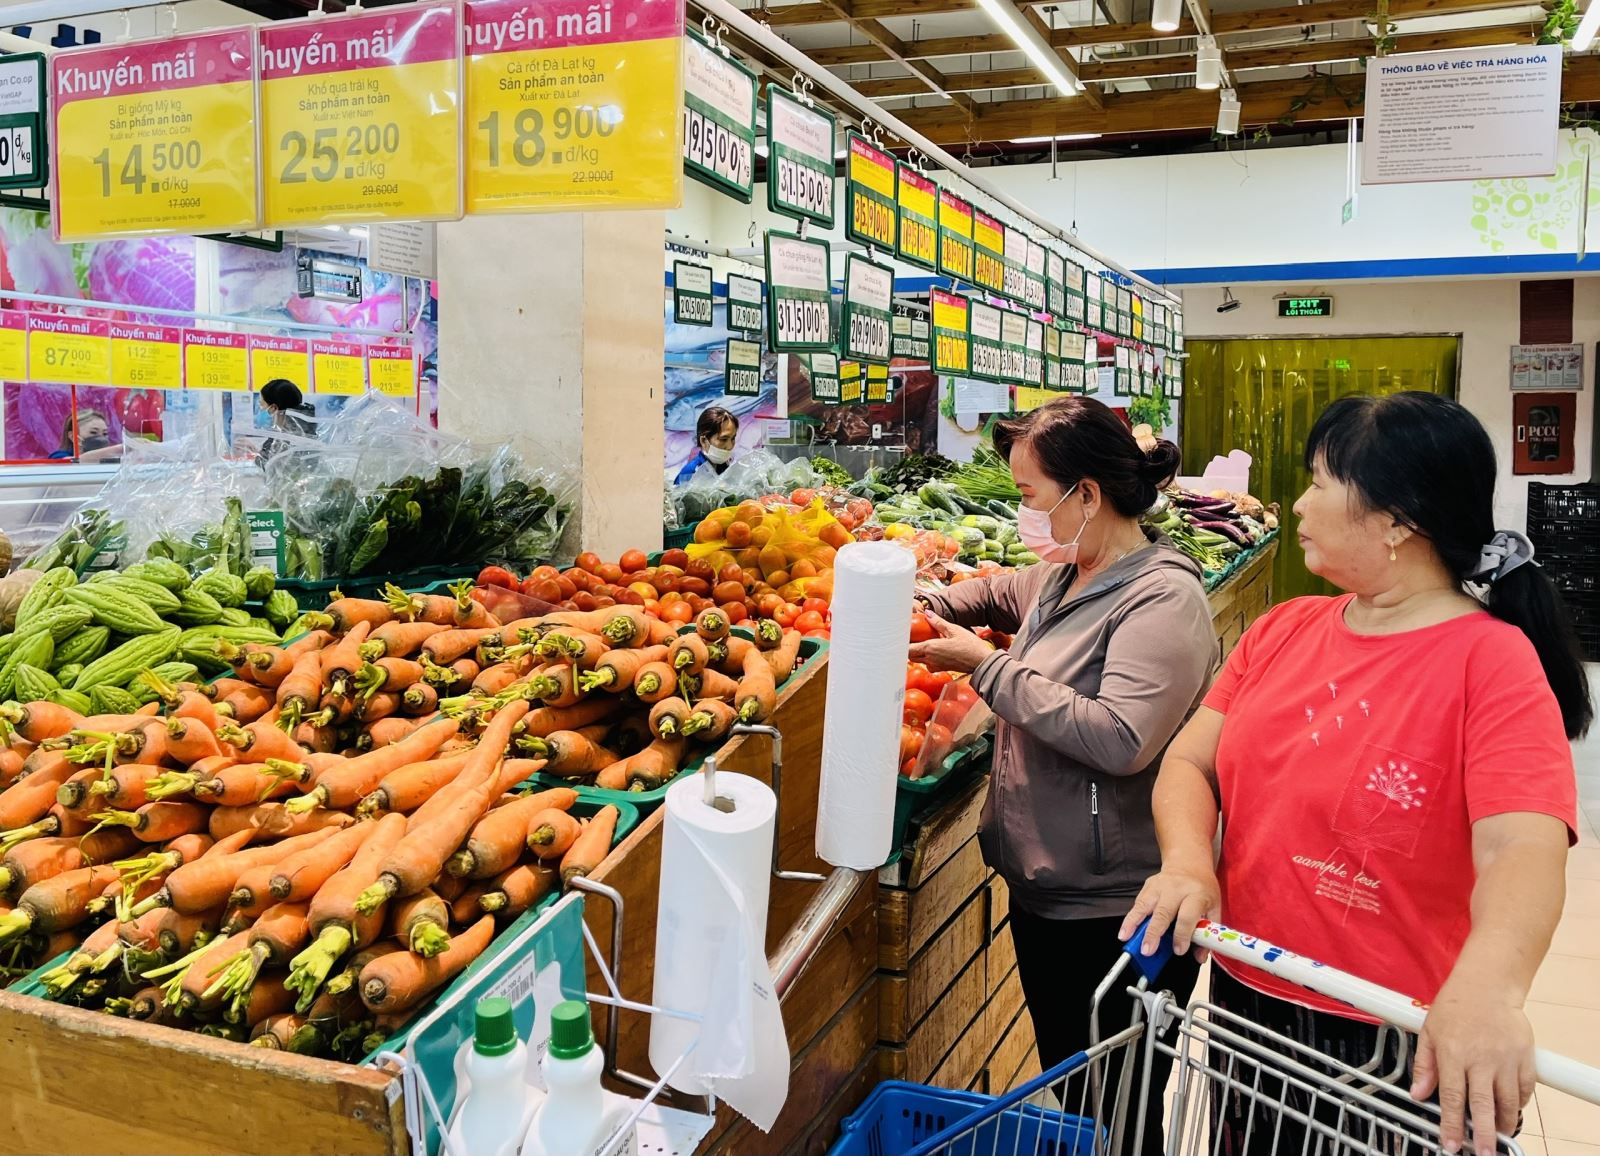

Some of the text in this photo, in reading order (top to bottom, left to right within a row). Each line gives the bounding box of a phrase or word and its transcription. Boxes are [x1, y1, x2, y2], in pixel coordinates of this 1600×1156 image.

[556, 4, 611, 37] mãi
[261, 29, 393, 74] huyến mãi
[58, 52, 195, 95] Khuyến mãi
[507, 56, 596, 74] Cà rốt Đà Lạt kg
[1381, 55, 1547, 75] THÔNG BÁO VỀ VIỆC TRẢ HÀNG HÓA
[10, 76, 33, 86] Co.op
[329, 83, 347, 95] qua
[350, 79, 365, 92] trái
[367, 78, 379, 92] kg
[500, 71, 605, 91] Sản phẩm an toàn
[129, 102, 153, 116] giống
[155, 99, 169, 114] Mỹ
[170, 99, 181, 112] kg
[300, 93, 390, 111] Sản phẩm an toàn
[109, 111, 193, 130] Sản phẩm an toàn
[357, 109, 374, 119] Nam
[565, 145, 599, 165] đ/kg
[357, 160, 385, 179] đ/kg
[572, 170, 614, 183] 22.900đ
[161, 176, 189, 194] đ/kg
[362, 184, 398, 196] 29.600đ
[781, 163, 823, 206] 31.500
[1290, 300, 1319, 308] EXIT
[29, 318, 69, 332] Khuyến
[779, 304, 820, 333] 31.500
[110, 327, 144, 341] Khuyến
[186, 333, 216, 346] Khuyến
[851, 319, 883, 347] 29.900
[252, 339, 279, 351] Khuyến
[314, 343, 337, 355] Khuyến
[1529, 425, 1559, 436] PCCC
